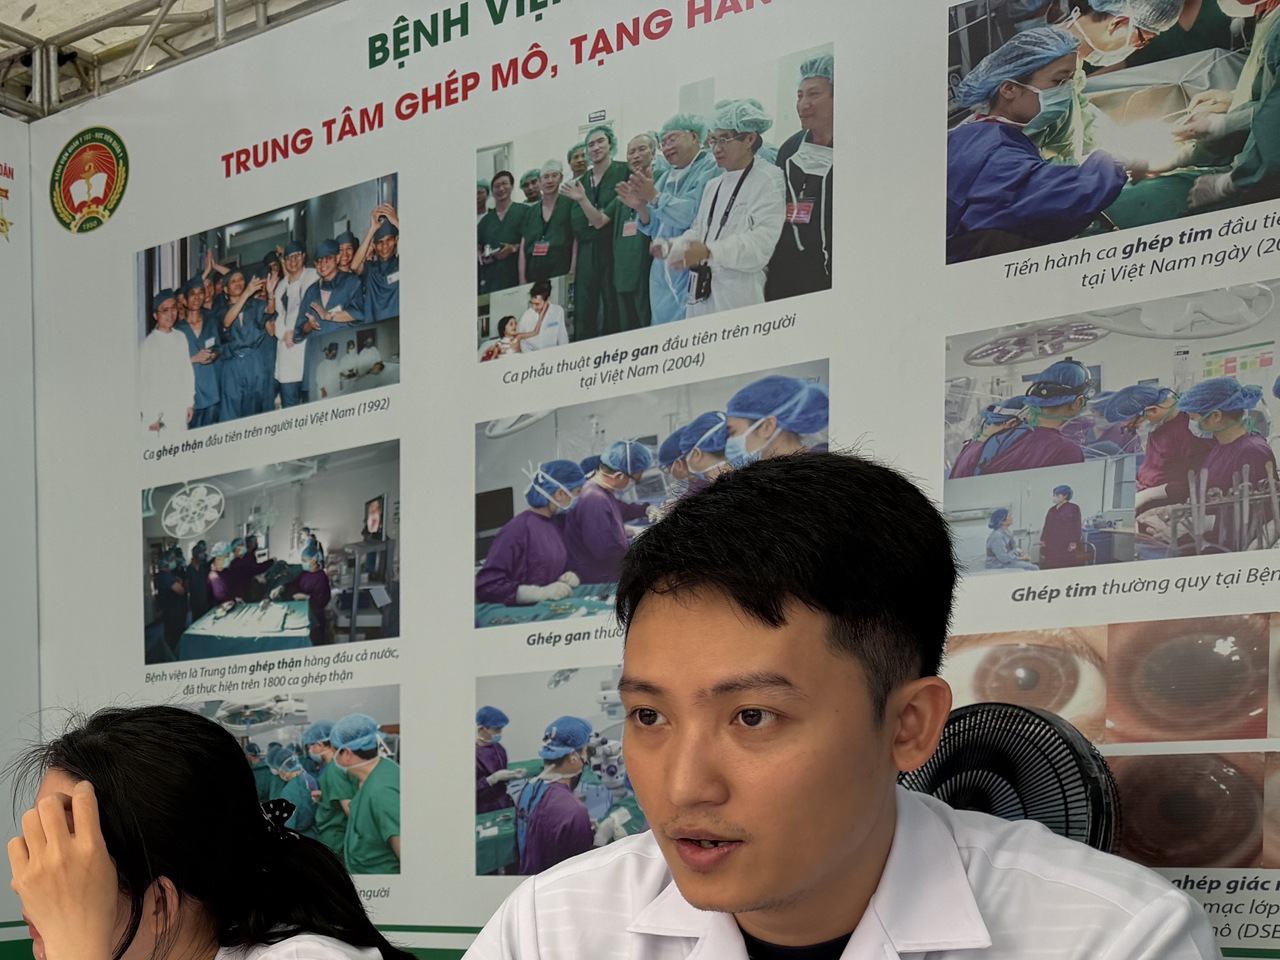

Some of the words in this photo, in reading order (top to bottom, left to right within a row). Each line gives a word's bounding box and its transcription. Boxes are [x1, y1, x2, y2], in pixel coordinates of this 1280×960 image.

[368, 3, 469, 69] BỆNH
[221, 127, 313, 178] TRUNG
[322, 105, 384, 146] TÂM
[394, 70, 480, 121] GHÉP
[491, 42, 558, 92] MÔ,
[570, 8, 673, 66] TẠNG
[1004, 257, 1039, 278] Tiến
[1044, 247, 1091, 271] hành
[1096, 246, 1117, 260] ca
[1121, 233, 1173, 260] ghép
[1178, 228, 1213, 245] tim
[1218, 219, 1257, 237] đầu
[1081, 268, 1106, 287] tại
[1111, 262, 1146, 282] Việt
[1149, 256, 1196, 275] Nam
[1200, 244, 1252, 267] ngày
[502, 370, 519, 384] Ca
[556, 355, 591, 373] thuật
[593, 348, 629, 369] ghép
[630, 344, 659, 362] gan
[661, 334, 689, 352] đầu
[691, 330, 718, 346] tiên
[721, 324, 749, 340] trên
[752, 312, 796, 336] người
[579, 372, 597, 390] tại
[599, 368, 624, 385] Việt
[626, 363, 659, 379] Nam
[662, 351, 705, 374] (2004)
[142, 449, 155, 460] Ca
[155, 443, 180, 461] ghép
[180, 438, 203, 453] thận
[224, 430, 242, 443] tiên
[243, 426, 263, 439] trên
[264, 417, 293, 436] người
[294, 414, 308, 430] tại
[309, 411, 329, 426] Việt
[329, 407, 355, 421] Nam
[357, 396, 390, 416] (1992)
[1011, 585, 1060, 603] Ghép
[1065, 582, 1096, 598] tim
[1102, 577, 1170, 595] thường
[1174, 575, 1211, 592] quy
[1215, 568, 1242, 588] tại
[526, 631, 562, 647] Ghép
[564, 631, 591, 646] gan
[144, 670, 167, 685] Bệnh
[168, 669, 187, 682] viện
[188, 667, 198, 679] là
[199, 666, 226, 679] Trung
[227, 663, 247, 675] tâm
[248, 659, 275, 675] ghép
[277, 657, 302, 672] thận
[303, 654, 331, 668] hàng
[354, 648, 368, 662] cả
[369, 647, 399, 660] nước,
[182, 684, 195, 695] đã
[196, 682, 217, 694] thực
[218, 680, 239, 694] hiện
[240, 678, 260, 690] trên
[263, 675, 287, 688] 1800
[286, 676, 299, 686] ca
[300, 671, 327, 688] ghép
[328, 668, 353, 683] thận
[1226, 876, 1271, 894] giác
